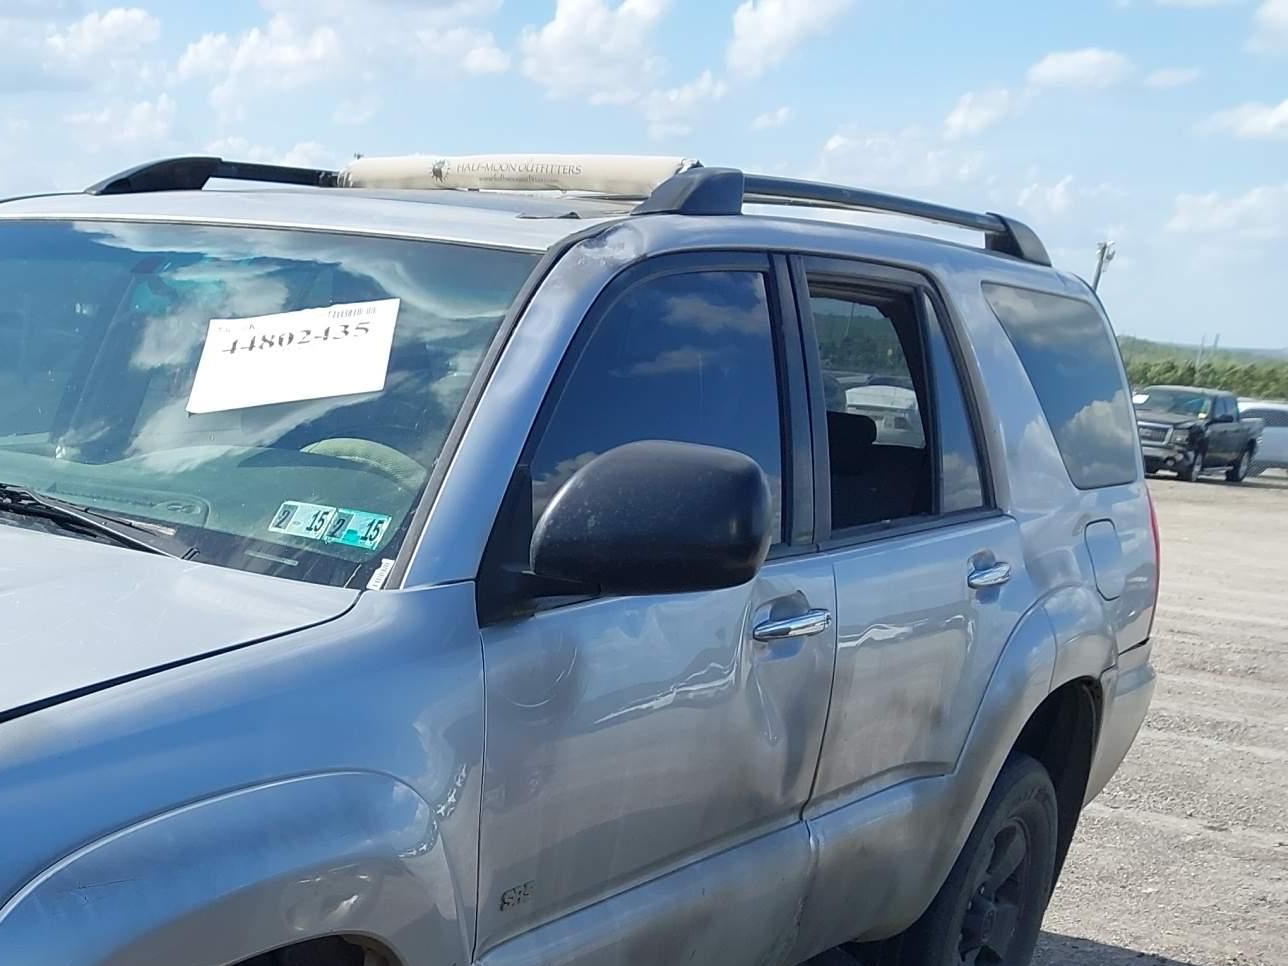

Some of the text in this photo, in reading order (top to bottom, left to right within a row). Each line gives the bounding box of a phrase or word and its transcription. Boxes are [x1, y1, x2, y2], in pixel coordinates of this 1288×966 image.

[518, 163, 583, 176] OUTFITTERS
[222, 322, 371, 354] 44802435
[305, 510, 329, 532] 15
[360, 518, 385, 542] 15
